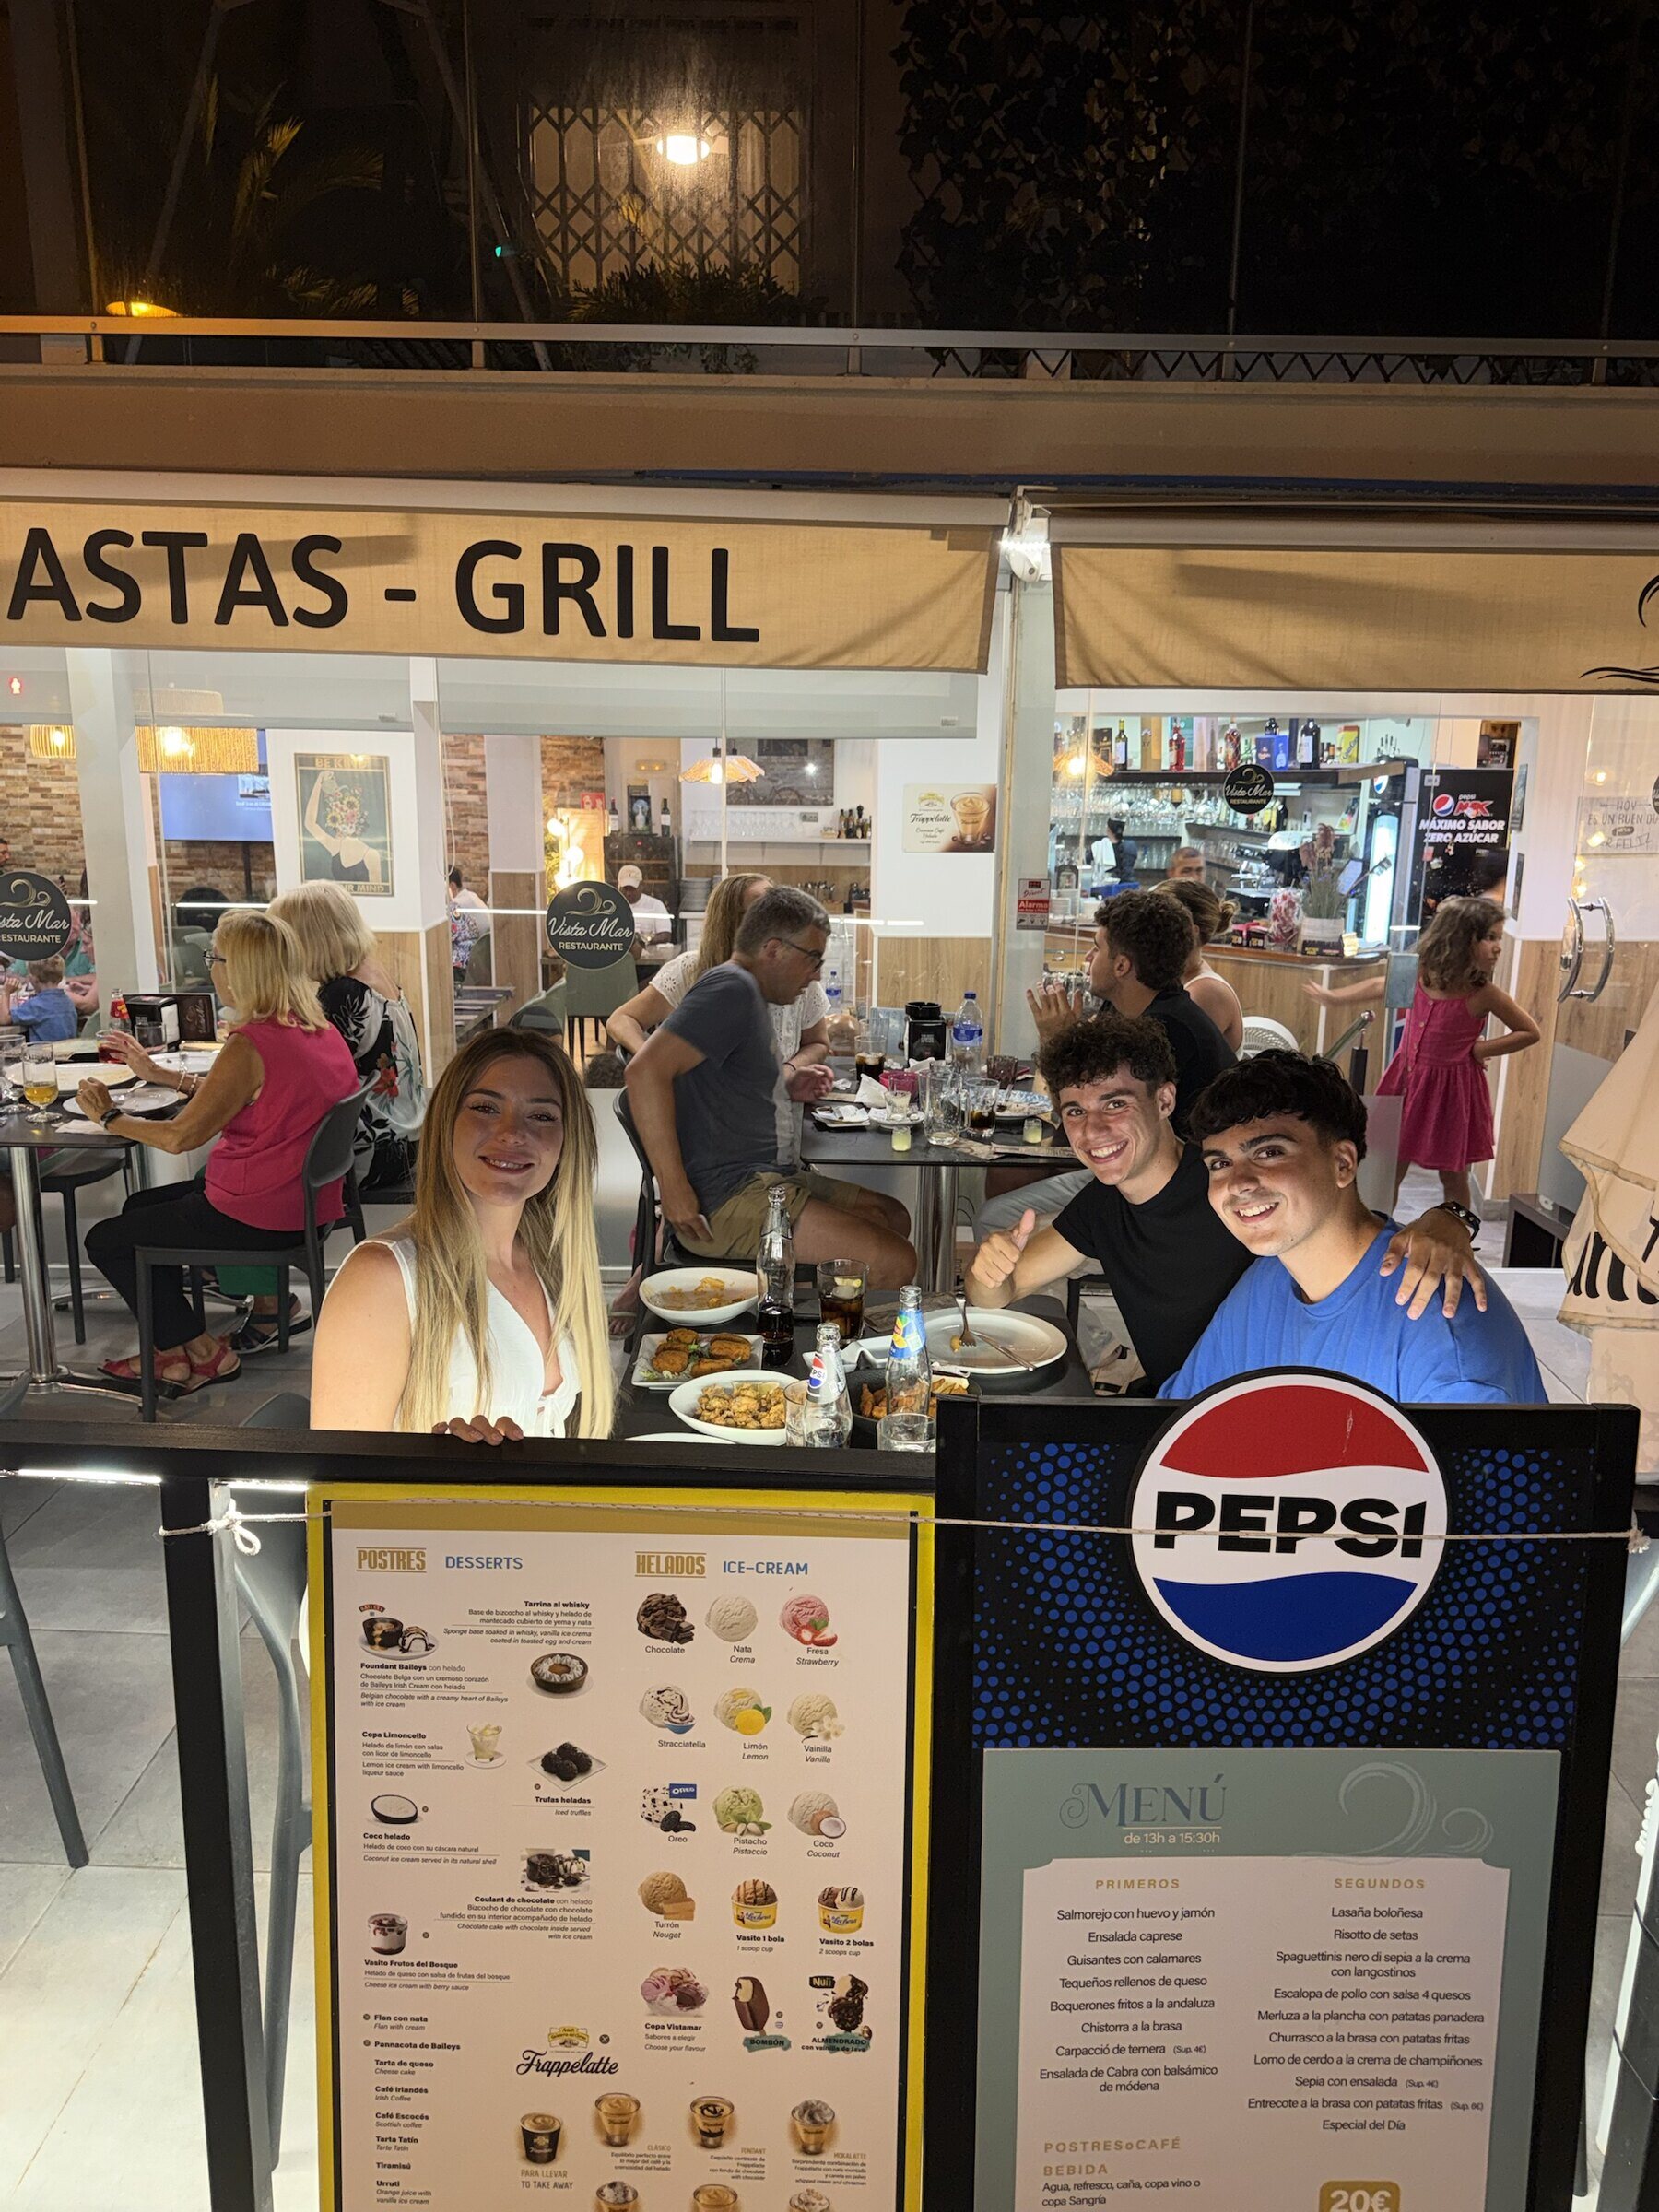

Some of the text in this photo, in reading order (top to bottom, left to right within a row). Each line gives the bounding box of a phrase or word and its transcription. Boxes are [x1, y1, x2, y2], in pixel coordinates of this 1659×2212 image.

[6, 528, 349, 629] ASTAS
[455, 540, 759, 642] GRILL
[1419, 817, 1505, 830] MÁXIMO SABOR
[1423, 830, 1500, 843] ZERO AZÚCAR
[25, 909, 70, 930] Mar
[548, 917, 634, 938] Vista Mar
[0, 934, 61, 943] ESTAURANTE
[559, 941, 624, 951] RESTAURANTE
[1153, 1491, 1427, 1558] PEPSI
[358, 1550, 426, 1571] POSTRES
[445, 1556, 523, 1570] DESSERTS
[636, 1554, 706, 1576] HELADOS
[723, 1560, 808, 1575] ICE-CREAM
[1124, 1831, 1220, 1844] de 13h a 15:30h
[1096, 1878, 1180, 1890] PRIMEROS
[1334, 1878, 1425, 1889] SEGUNDOS
[1057, 1907, 1215, 1922] Salmorejo con huevo y jamón
[1332, 1907, 1423, 1919] Lasaña boloñesa
[1088, 1931, 1182, 1944] Ensalada caprese
[1334, 1929, 1418, 1941] Risotto de setas
[1067, 1953, 1202, 1966] Guisantes con calamares
[1276, 1951, 1471, 1965] Spaguettinis nero di sepia a la crema
[1331, 1966, 1416, 1980] con langostinos
[1059, 1975, 1207, 1991] Tequeños rellenos de queso
[1081, 2020, 1182, 2033] Chistorra a la brasa
[1112, 2043, 1126, 2054] de
[1128, 2044, 1166, 2054] ternera
[1295, 2076, 1398, 2088] Sepia con ensalada
[1323, 2120, 1406, 2132] Especial del Día
[1043, 2164, 1108, 2176] BEBIDA
